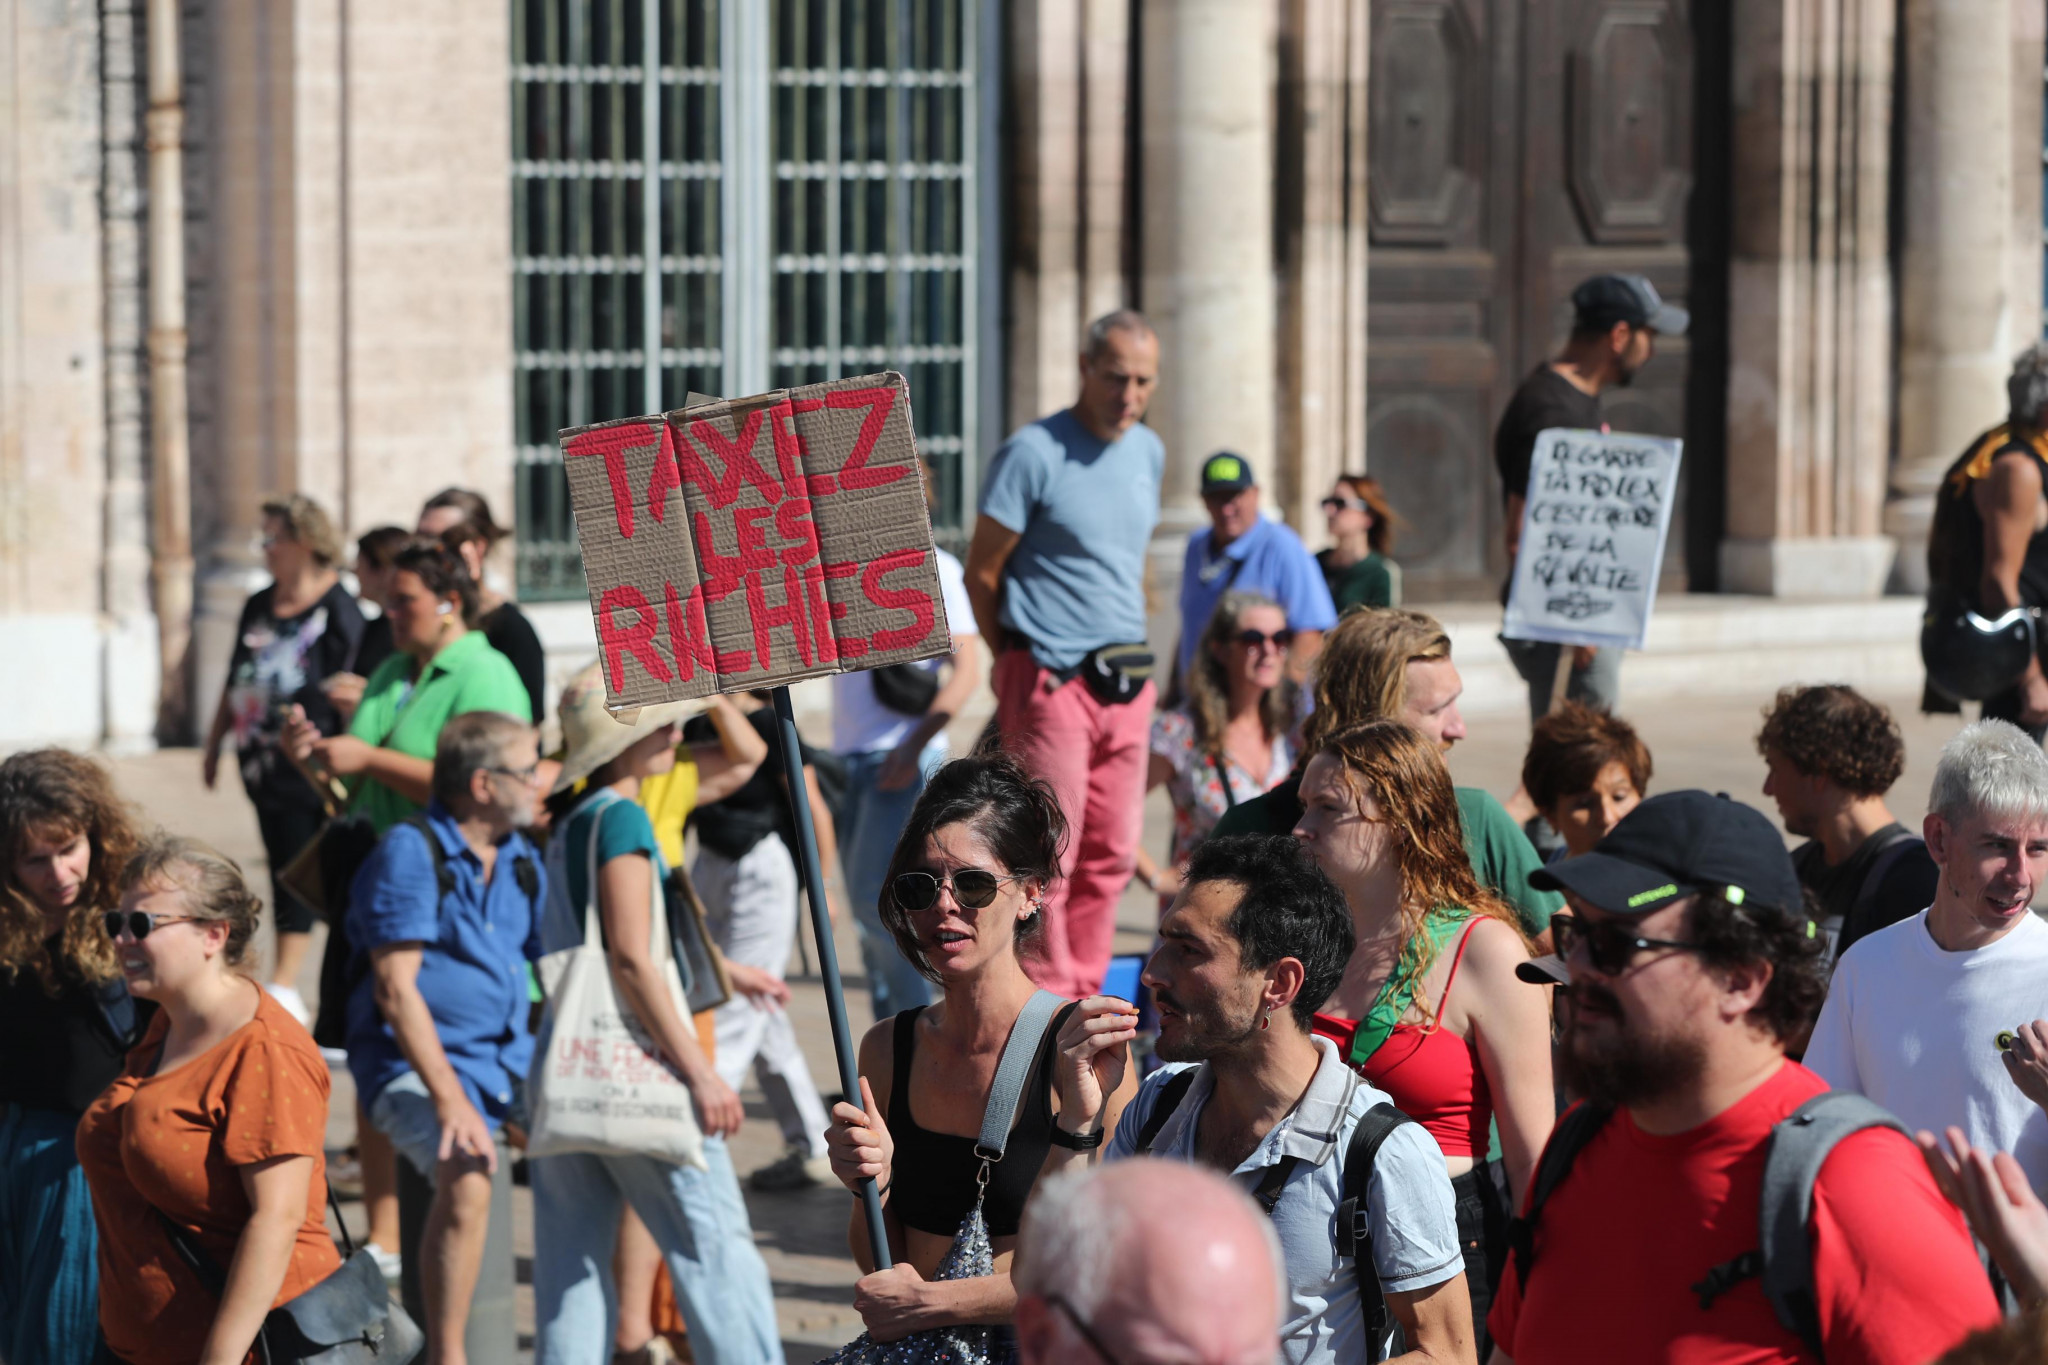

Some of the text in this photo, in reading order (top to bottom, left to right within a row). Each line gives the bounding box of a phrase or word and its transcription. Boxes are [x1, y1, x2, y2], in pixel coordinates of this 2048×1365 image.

[566, 387, 912, 539] TAXEZ
[1544, 471, 1661, 502] TA ROLEX
[694, 499, 822, 580] LES
[1541, 531, 1617, 561] DE LA
[599, 548, 934, 695] RICHES
[557, 1036, 604, 1065] UNE
